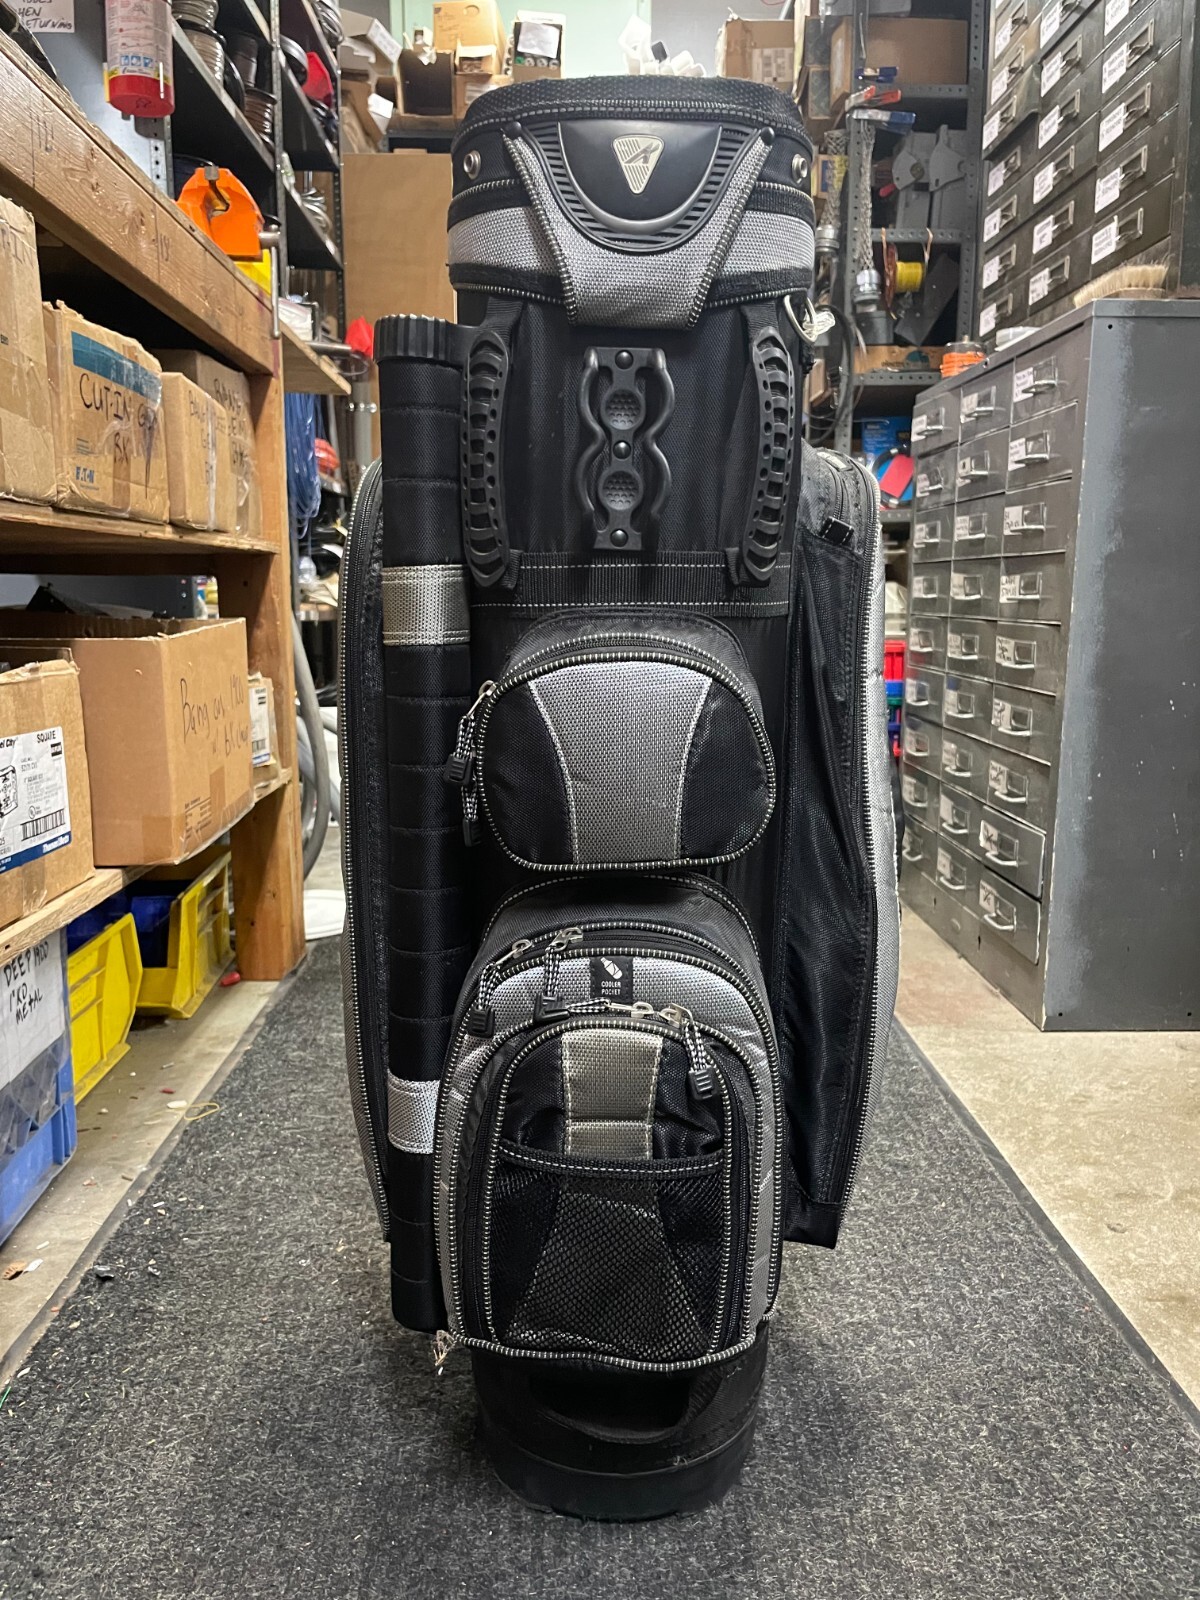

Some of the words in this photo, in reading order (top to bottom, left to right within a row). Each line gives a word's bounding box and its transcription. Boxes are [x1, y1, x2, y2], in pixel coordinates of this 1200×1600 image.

[17, 7, 42, 17] HEN
[3, 948, 31, 988] DEEP
[601, 980, 621, 988] COOLER
[601, 988, 621, 996] POCKET
